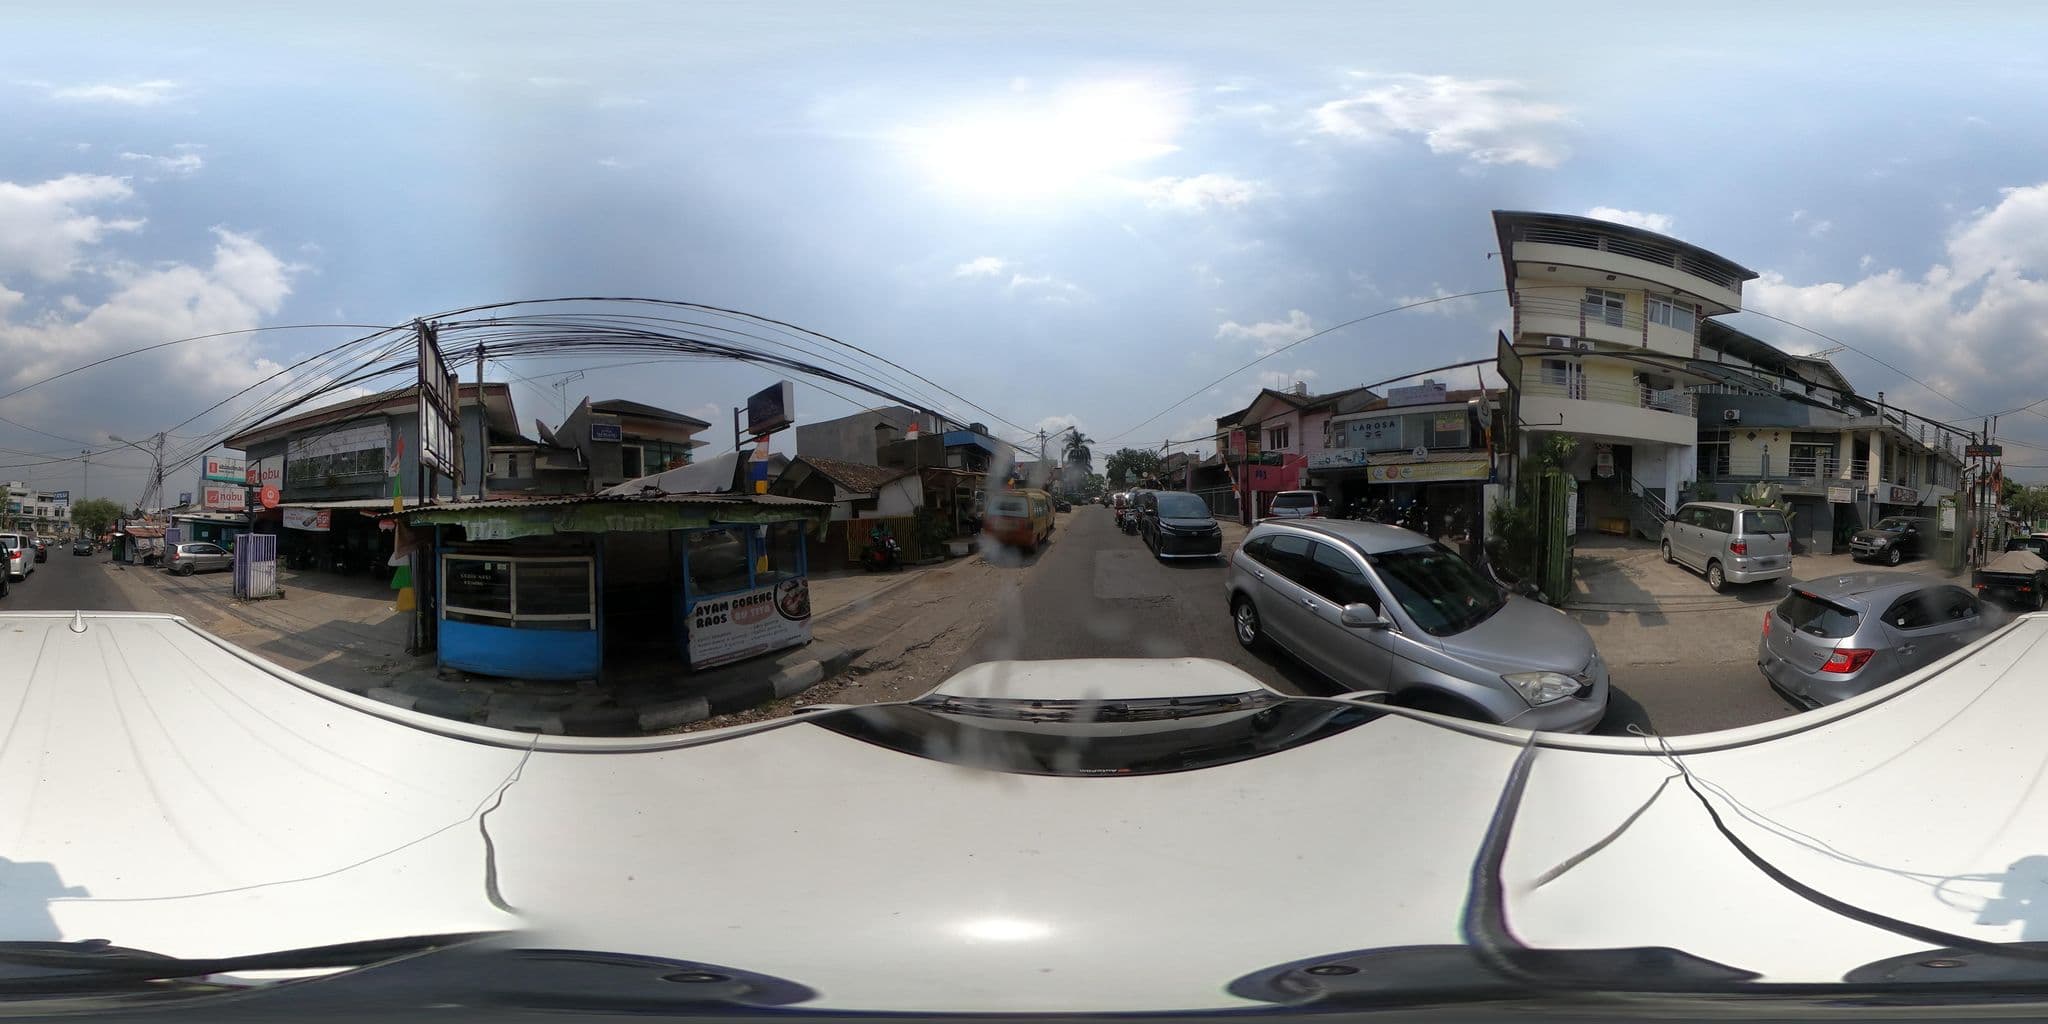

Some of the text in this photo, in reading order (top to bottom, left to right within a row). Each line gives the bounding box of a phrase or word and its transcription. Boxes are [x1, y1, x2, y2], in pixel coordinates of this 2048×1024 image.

[1352, 420, 1395, 432] LAROSA
[220, 491, 242, 501] nobu
[696, 592, 772, 617] AYAM GORENG
[696, 613, 728, 629] RAOS
